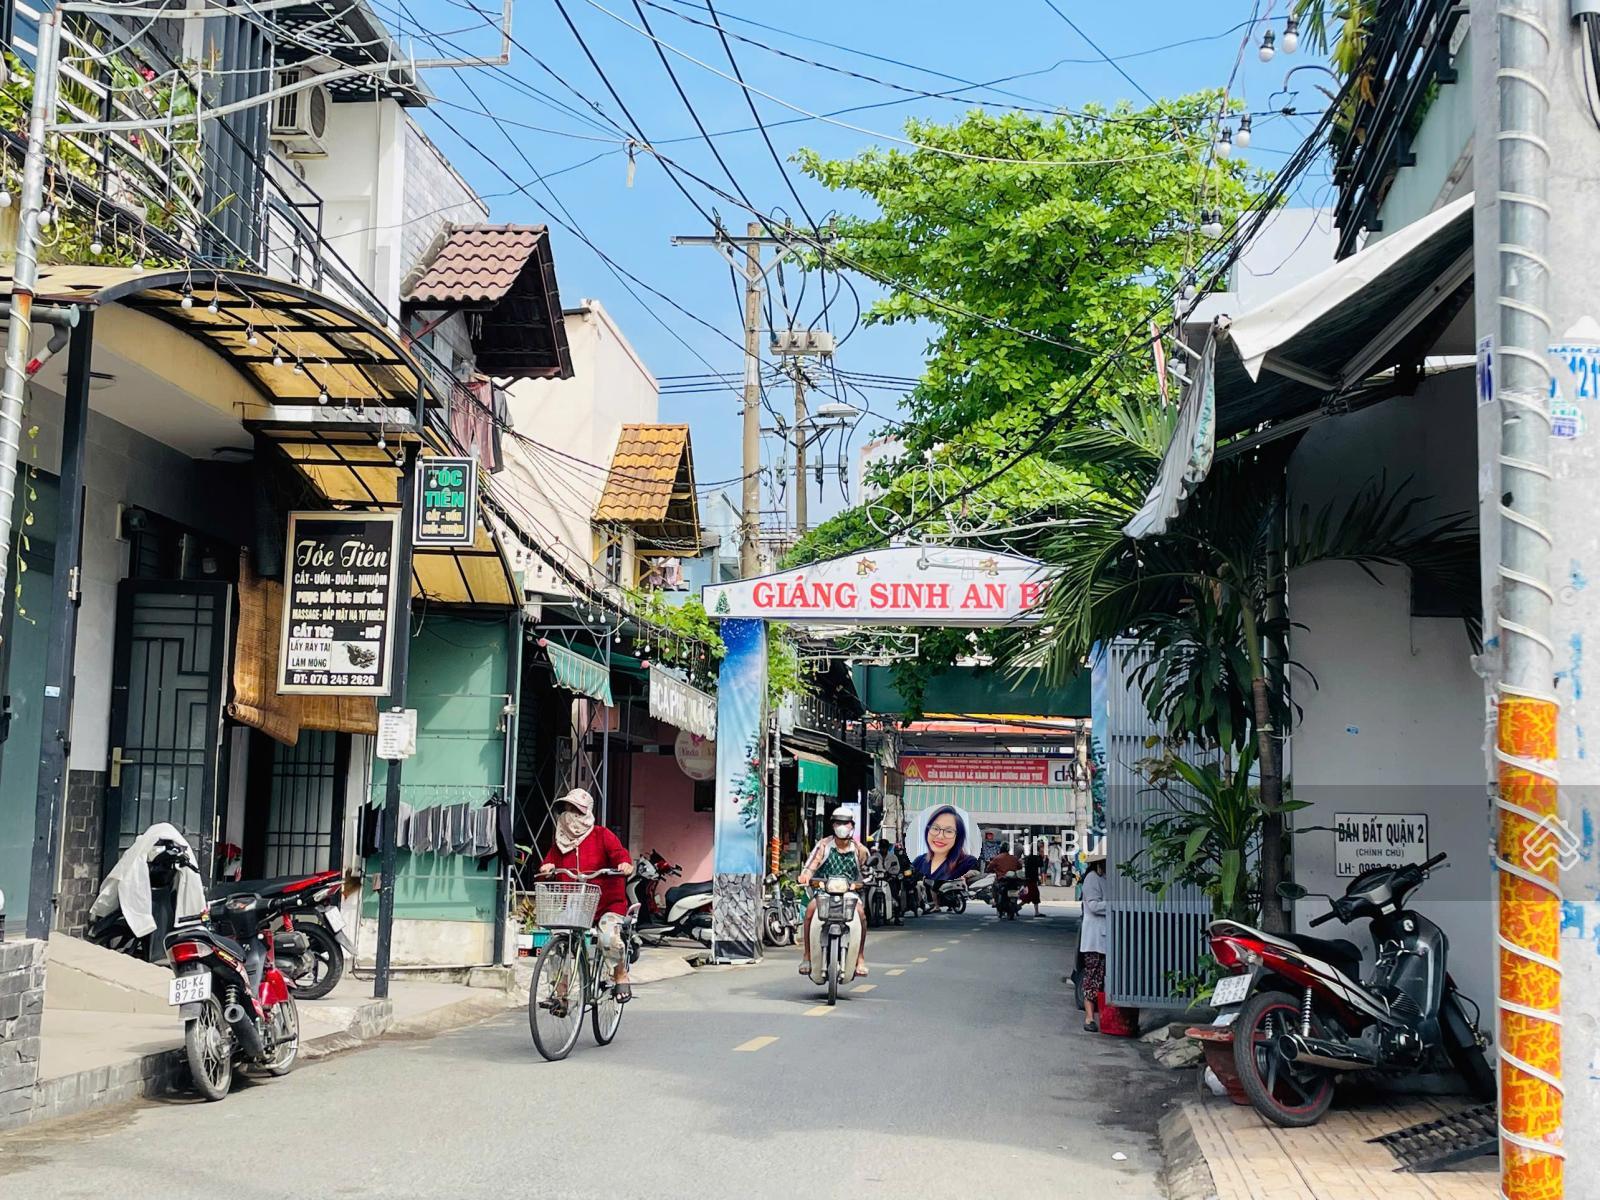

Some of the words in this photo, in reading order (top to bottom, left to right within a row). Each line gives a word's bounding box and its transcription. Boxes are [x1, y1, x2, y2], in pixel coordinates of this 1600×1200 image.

[425, 487, 464, 507] TIÊN
[296, 540, 334, 566] Tóc
[340, 540, 388, 567] Tiên
[752, 576, 857, 609] GIÁNG
[870, 583, 950, 609] SINH
[960, 583, 1006, 609] AN
[292, 608, 320, 620] MASSAGE
[292, 622, 313, 638] CẮT
[314, 624, 334, 638] TÓC
[310, 674, 328, 684] 076
[330, 675, 348, 685] 245
[1338, 817, 1359, 842] BÁN
[1363, 816, 1383, 842] ĐẤT
[1386, 818, 1414, 847] QUẬN
[1417, 824, 1424, 843] 2
[1338, 862, 1355, 874] LH:
